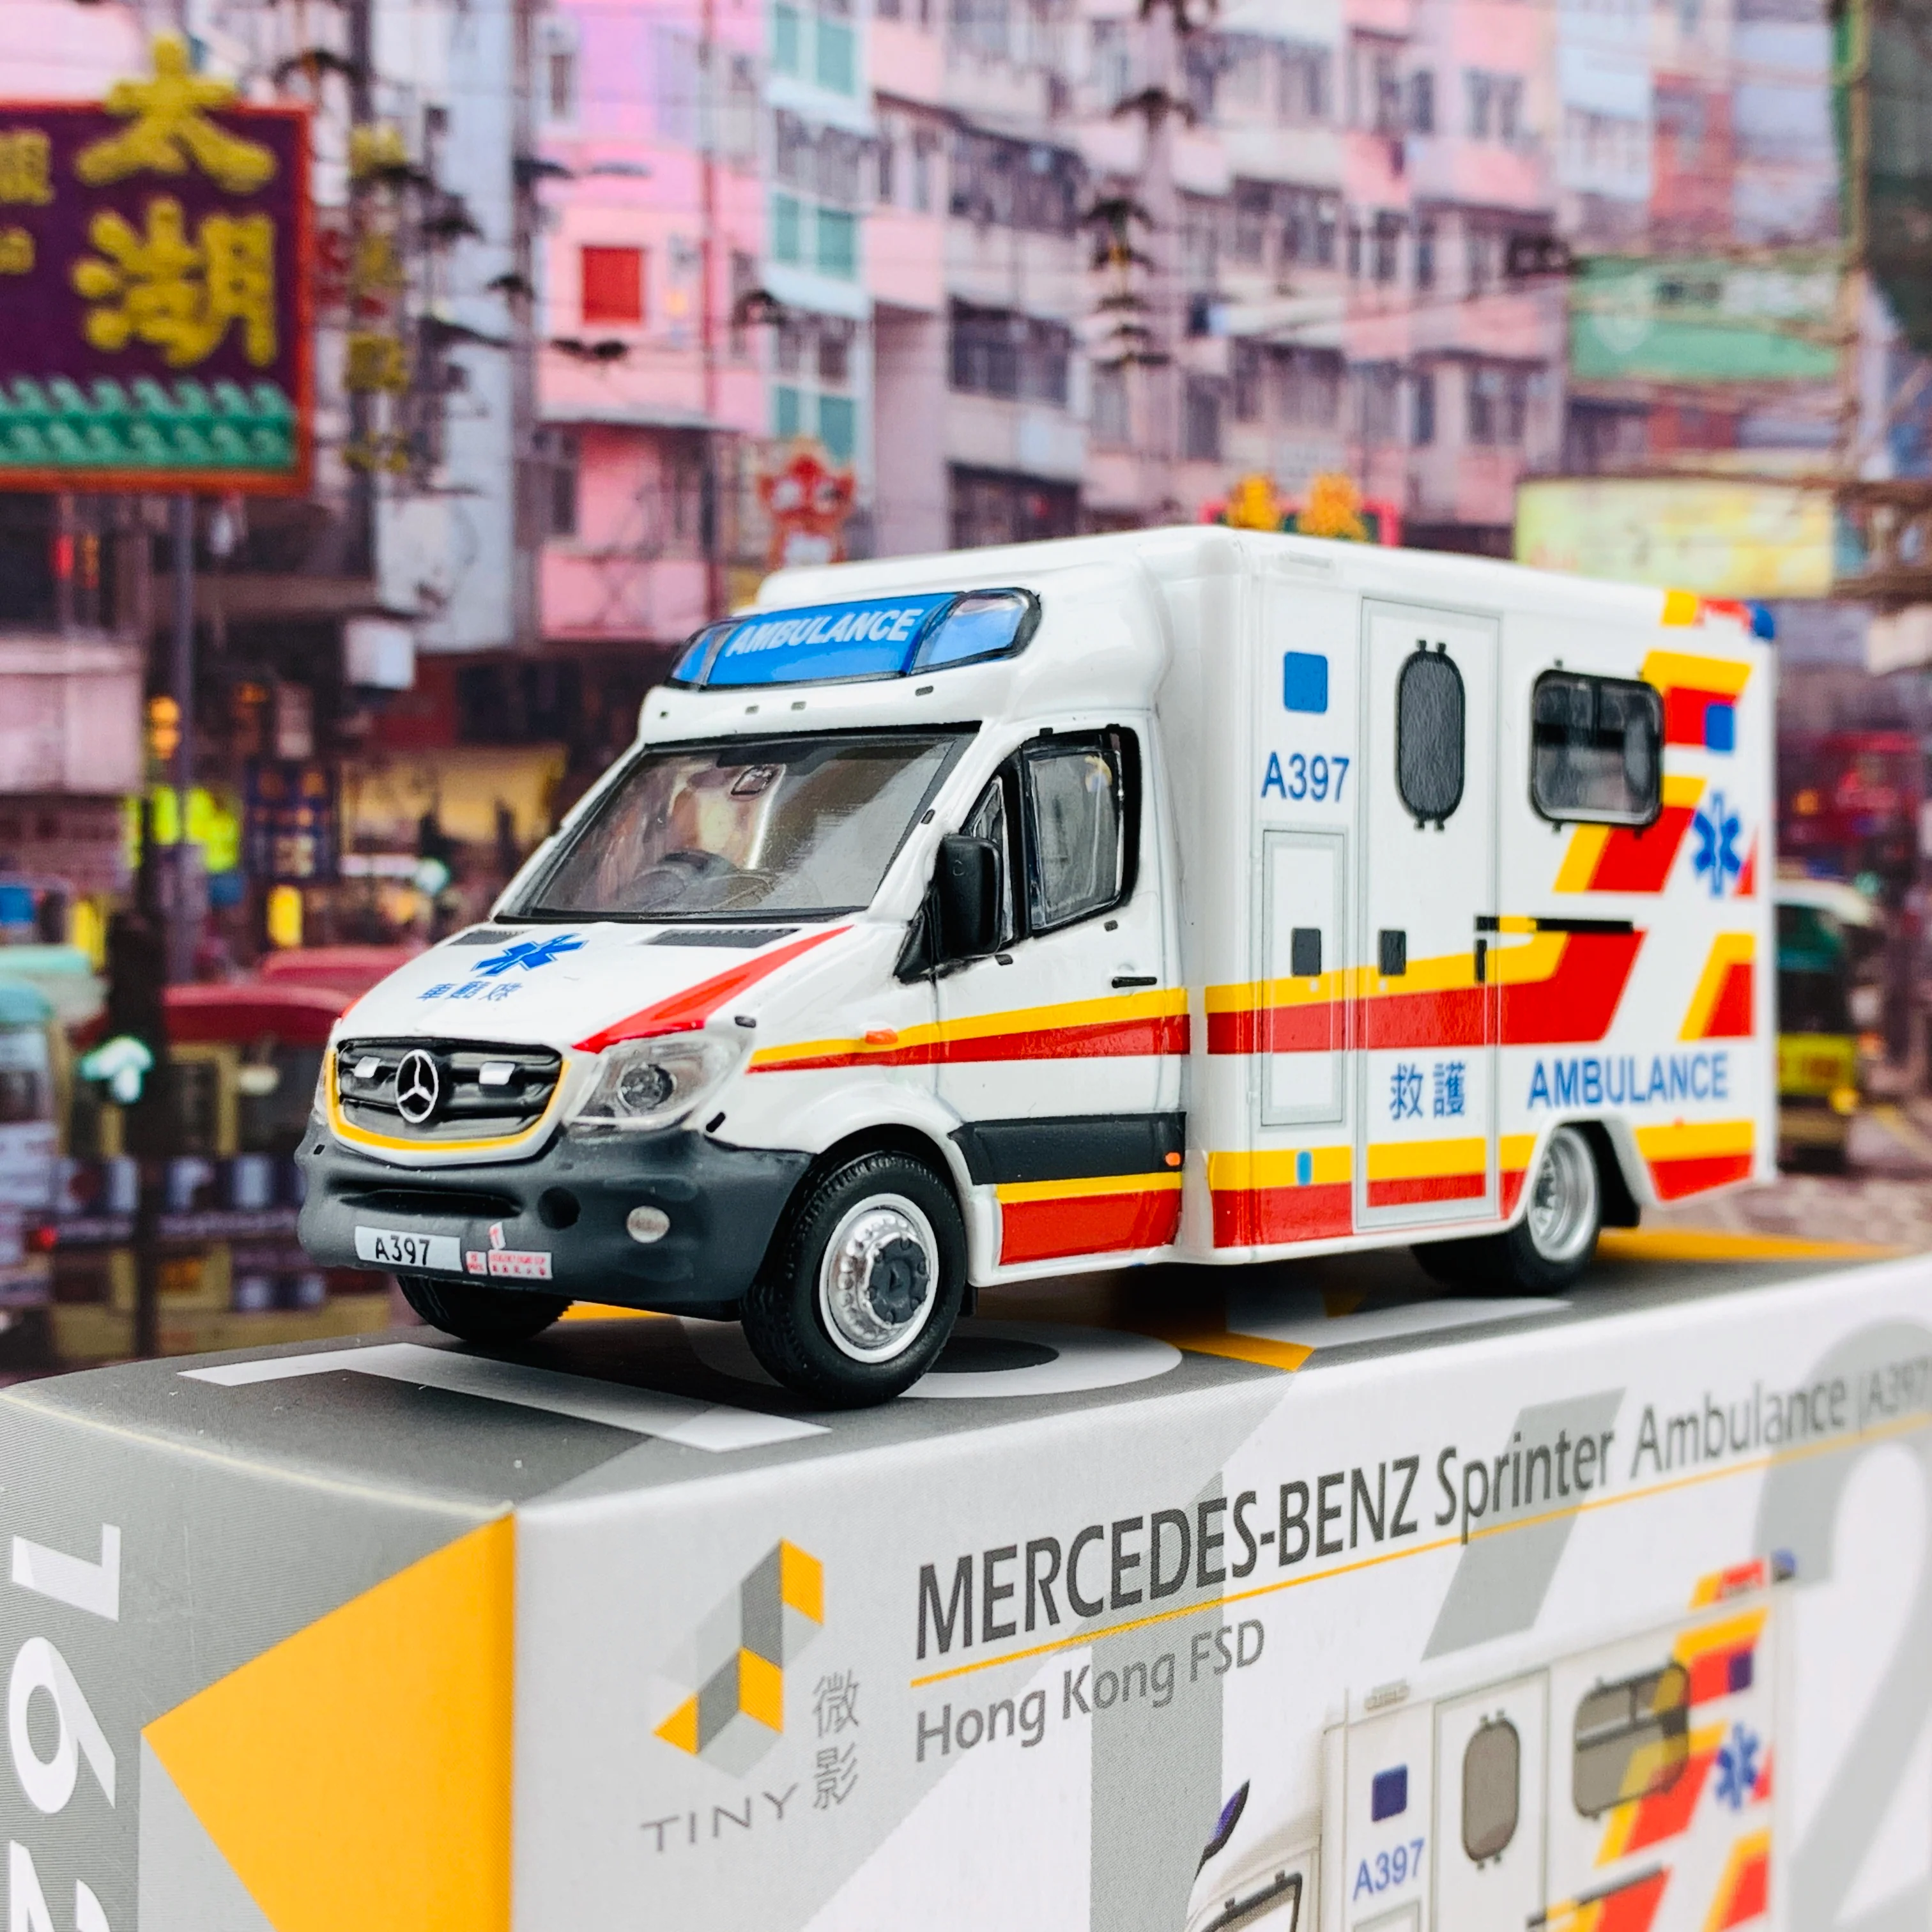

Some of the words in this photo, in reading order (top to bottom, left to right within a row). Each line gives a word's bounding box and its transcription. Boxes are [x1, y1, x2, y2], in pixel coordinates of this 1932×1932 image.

[724, 608, 924, 658] AMBULANCE
[1261, 751, 1351, 804] A397
[1389, 1061, 1466, 1121] 救護
[1527, 1051, 1730, 1110] AMBULANCE
[375, 1234, 431, 1266] A397
[916, 1455, 1422, 1660] MERCEDES-BENZ
[1434, 1430, 1615, 1545] Sprinter
[1630, 1375, 1847, 1479] Ambulance
[916, 1689, 1046, 1763] Hong
[1061, 1651, 1176, 1720] Kong
[1189, 1618, 1266, 1683] FSD
[812, 1669, 860, 1811] 微影
[640, 1782, 799, 1852] TINY
[1352, 1836, 1425, 1902] A397
